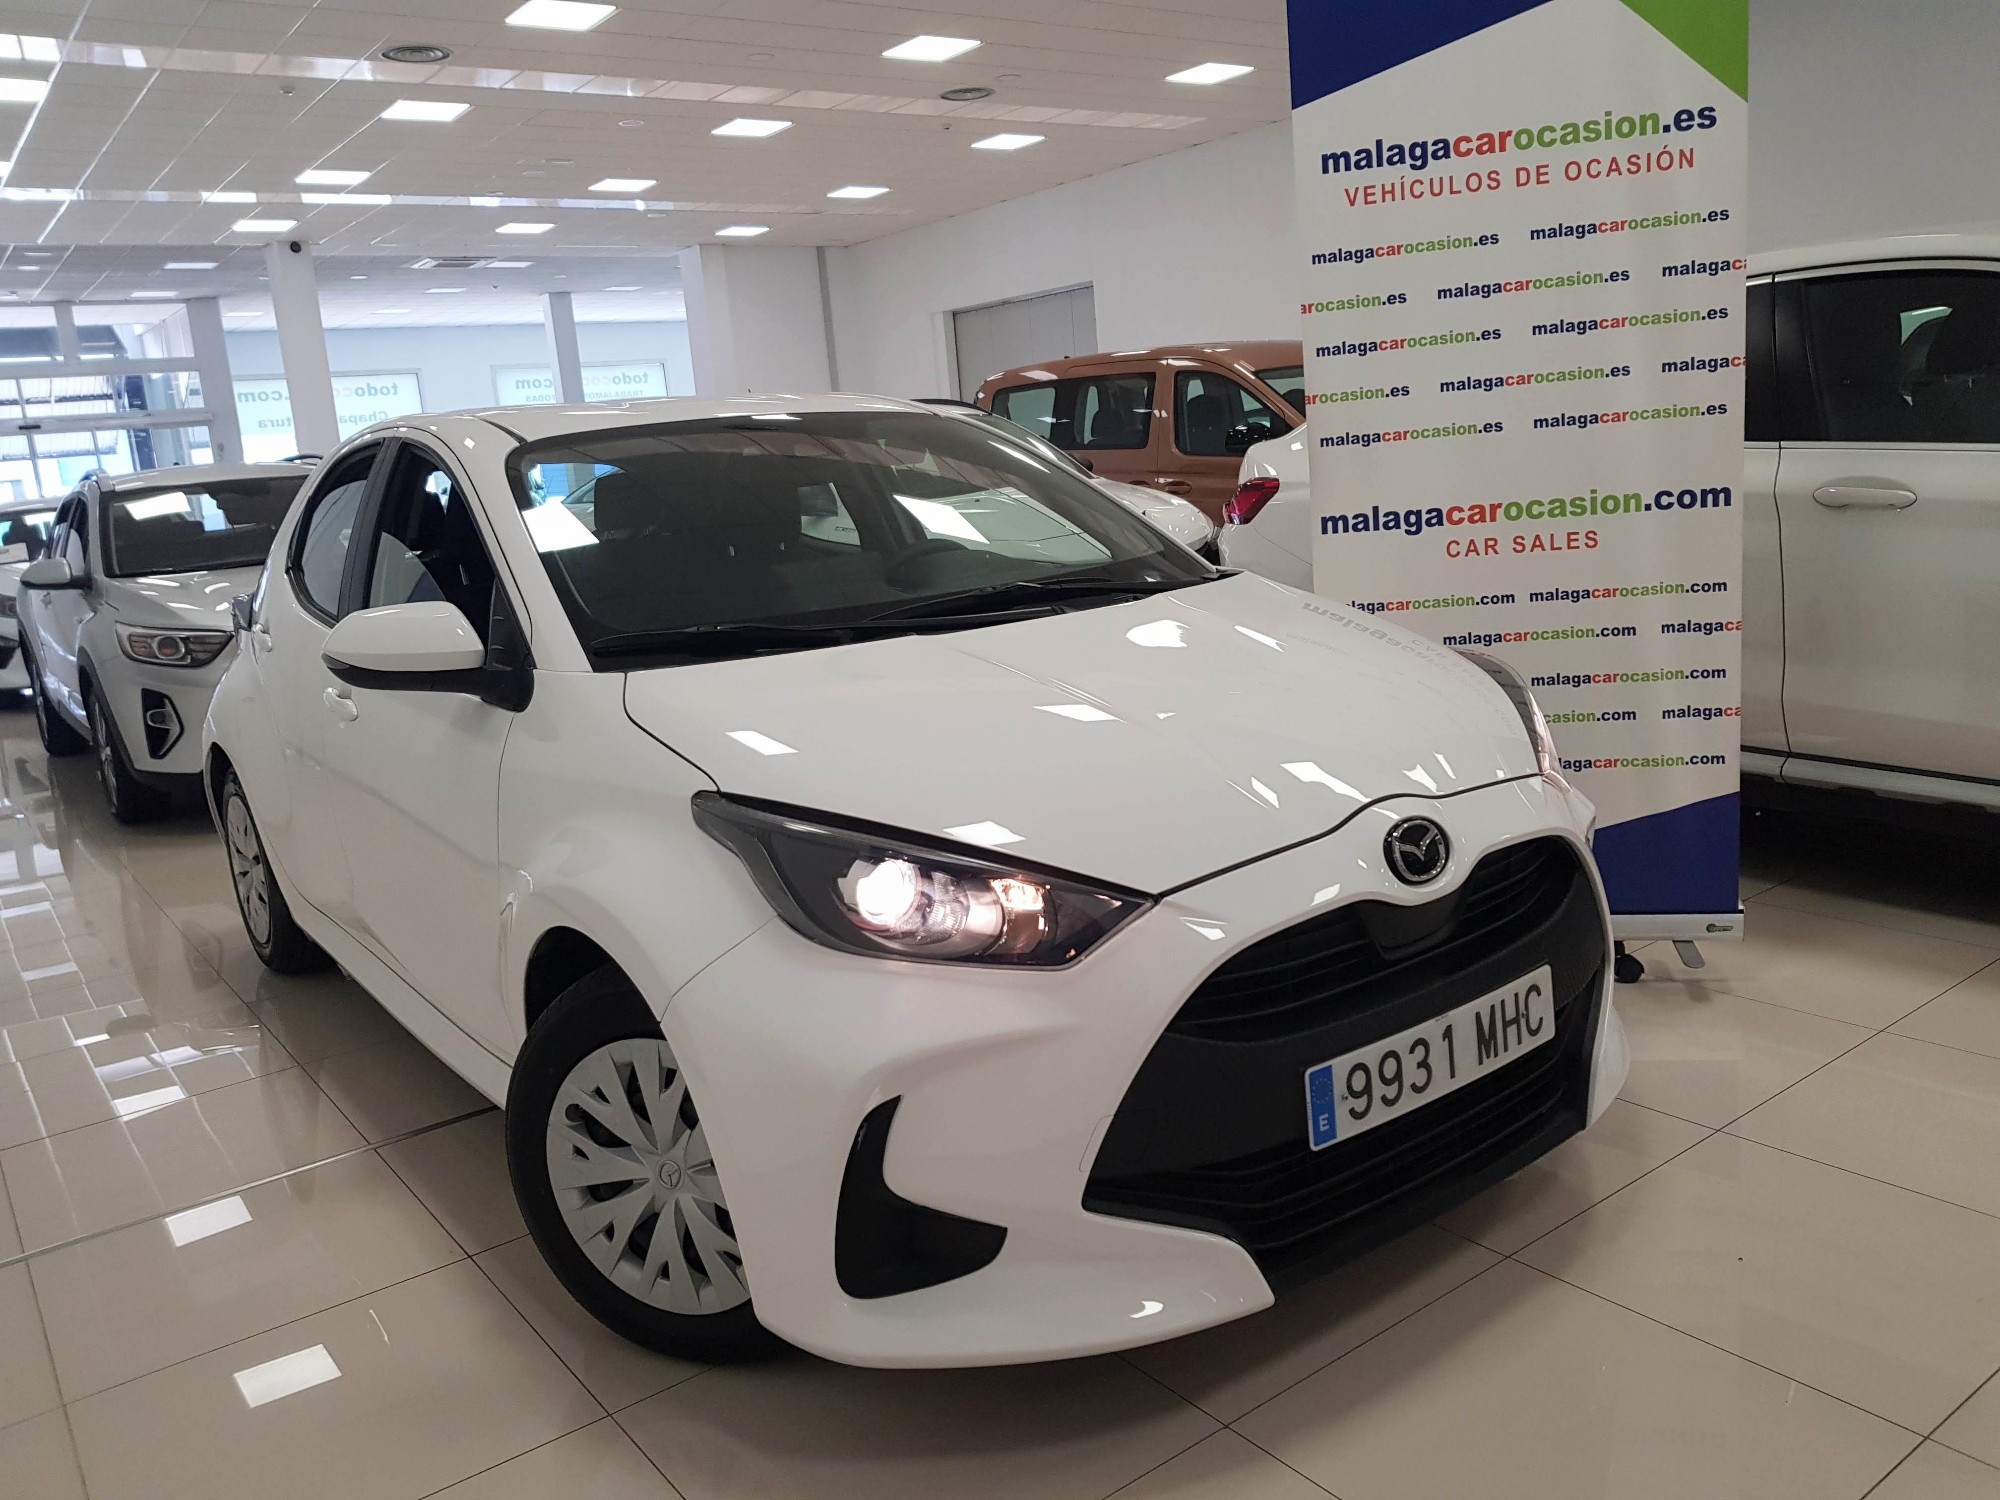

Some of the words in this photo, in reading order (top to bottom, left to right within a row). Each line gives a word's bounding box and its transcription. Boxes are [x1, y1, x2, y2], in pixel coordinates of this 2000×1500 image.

[1321, 105, 1717, 175] malagacarocasion.es
[1344, 169, 1501, 207] VEHÍCULOS
[1515, 164, 1550, 187] DE
[1564, 145, 1696, 182] OCASIÓN
[1531, 208, 1729, 240] malagacarocasion.es
[1312, 232, 1499, 265] malagacarocasion.es
[1437, 268, 1630, 300] malagacarocasion.es
[1532, 306, 1728, 336] malagacarocasion.es
[1316, 327, 1501, 357] malagacarocasion.es
[1440, 364, 1631, 393] malagacarocasion.es
[1533, 403, 1727, 429] malagacarocasion.es
[1320, 420, 1503, 448] malagacarocasion.es
[1320, 485, 1731, 535] malagacarocasion.com
[1446, 537, 1499, 558] CAR
[1512, 530, 1599, 554] SALES
[1529, 580, 1727, 603] malagacarocasion.com
[1443, 625, 1636, 648] malagacarocasion.com
[1531, 668, 1726, 689] malagacarocasion.com
[1346, 1024, 1456, 1120] 9931
[1475, 984, 1544, 1066] MHC
[1319, 1113, 1330, 1132] E
